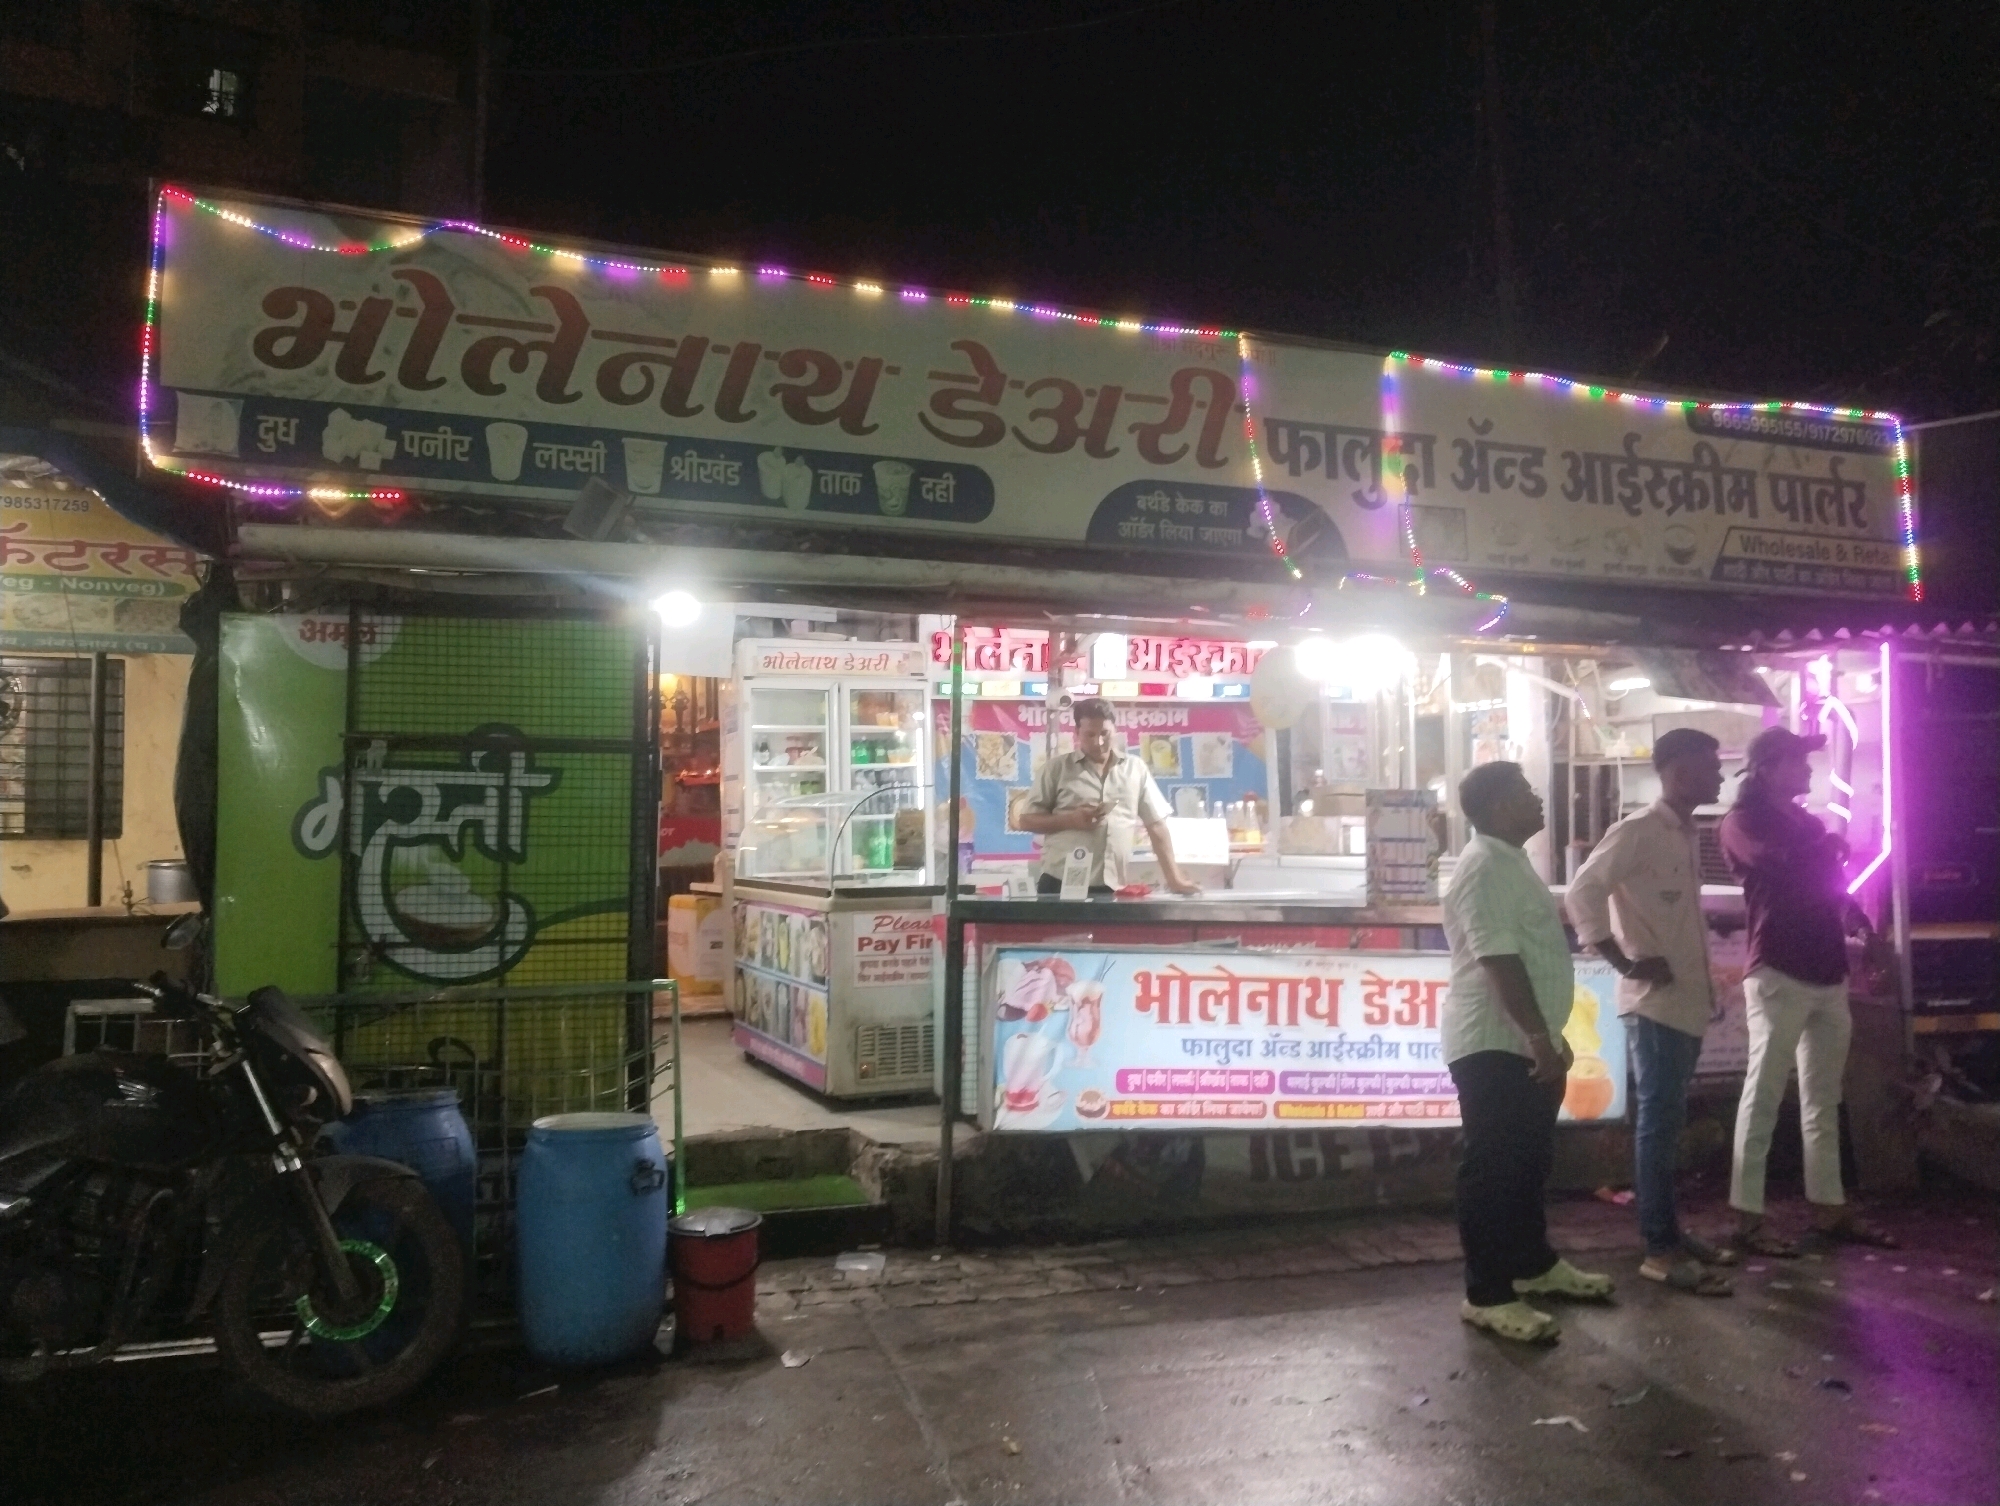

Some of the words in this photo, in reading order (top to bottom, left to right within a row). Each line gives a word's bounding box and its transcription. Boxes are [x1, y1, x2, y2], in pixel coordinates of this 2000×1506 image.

[252, 268, 900, 436] भोलेनाथ
[917, 339, 1246, 470] डेअरी
[257, 415, 300, 453] दुध
[401, 426, 473, 463] पनीर
[533, 440, 608, 475] लस्सी
[670, 448, 742, 488] श्रीखंड
[818, 467, 861, 497] ताक
[920, 472, 956, 504] दही
[1561, 431, 1760, 520] आईस्क्रीम
[1767, 456, 1868, 529] पार्लर
[0, 496, 90, 513] 985317259
[1853, 543, 1891, 565] Reta
[762, 651, 838, 671] भोलेनाथ
[844, 652, 890, 672] डेअरी
[872, 915, 933, 933] Pleas
[857, 936, 901, 955] Pay
[905, 934, 934, 950] Fir
[1133, 963, 1344, 1028] भोलेनाथ
[1360, 970, 1450, 1029] डेअ
[1182, 1038, 1254, 1065] फालुदा
[1308, 1033, 1400, 1062] आईस्क्रीम
[1407, 1042, 1442, 1061] पाल
